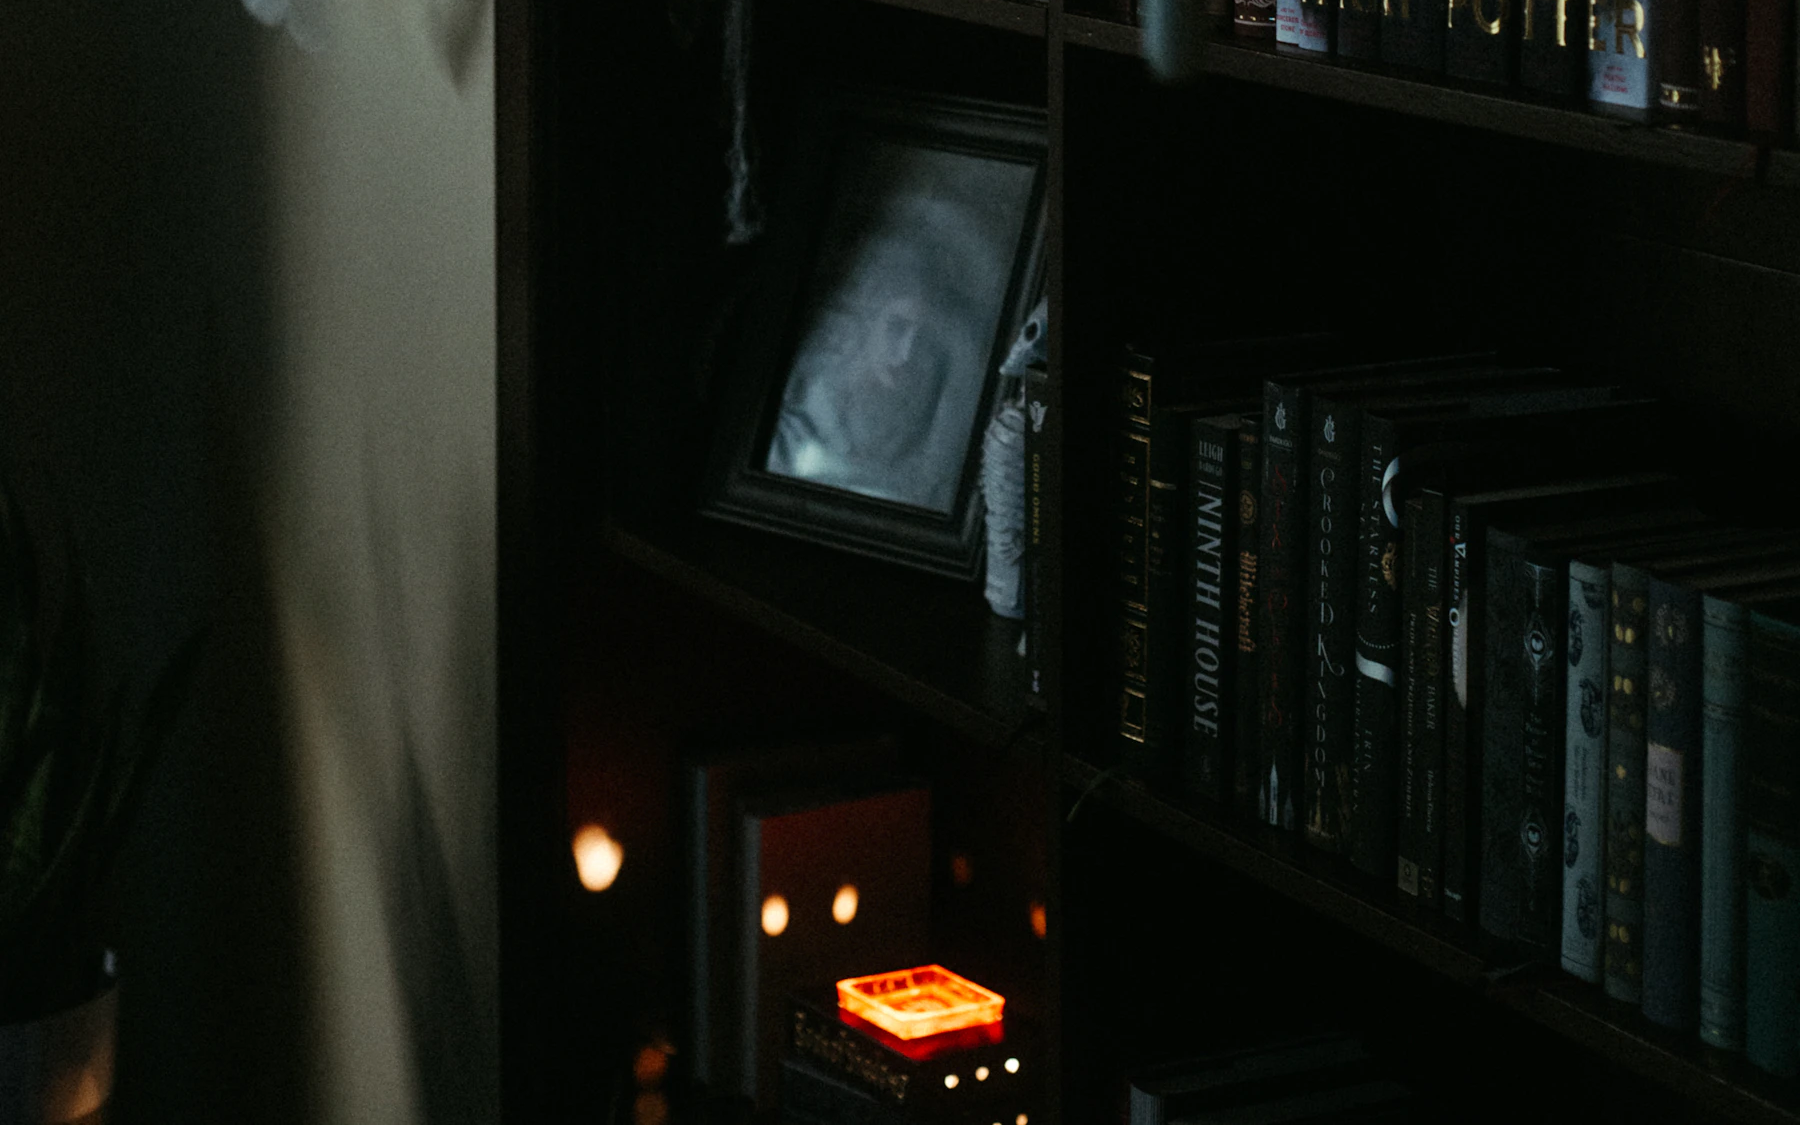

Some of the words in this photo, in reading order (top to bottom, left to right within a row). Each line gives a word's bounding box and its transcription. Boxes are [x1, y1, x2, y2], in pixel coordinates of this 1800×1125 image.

[1032, 453, 1041, 493] GOOD
[1198, 439, 1224, 463] LEIGH
[1371, 444, 1383, 484] THE
[1032, 496, 1041, 545] OMENS
[1195, 490, 1223, 611] NINTH
[1319, 466, 1336, 627] CROOKED
[1367, 499, 1382, 614] STARLESS
[1427, 566, 1438, 592] THE
[1407, 612, 1418, 645] PRIDE
[1193, 616, 1220, 739] HOUSE
[1314, 632, 1346, 788] KINGDOM
[1426, 684, 1437, 730] BAKER
